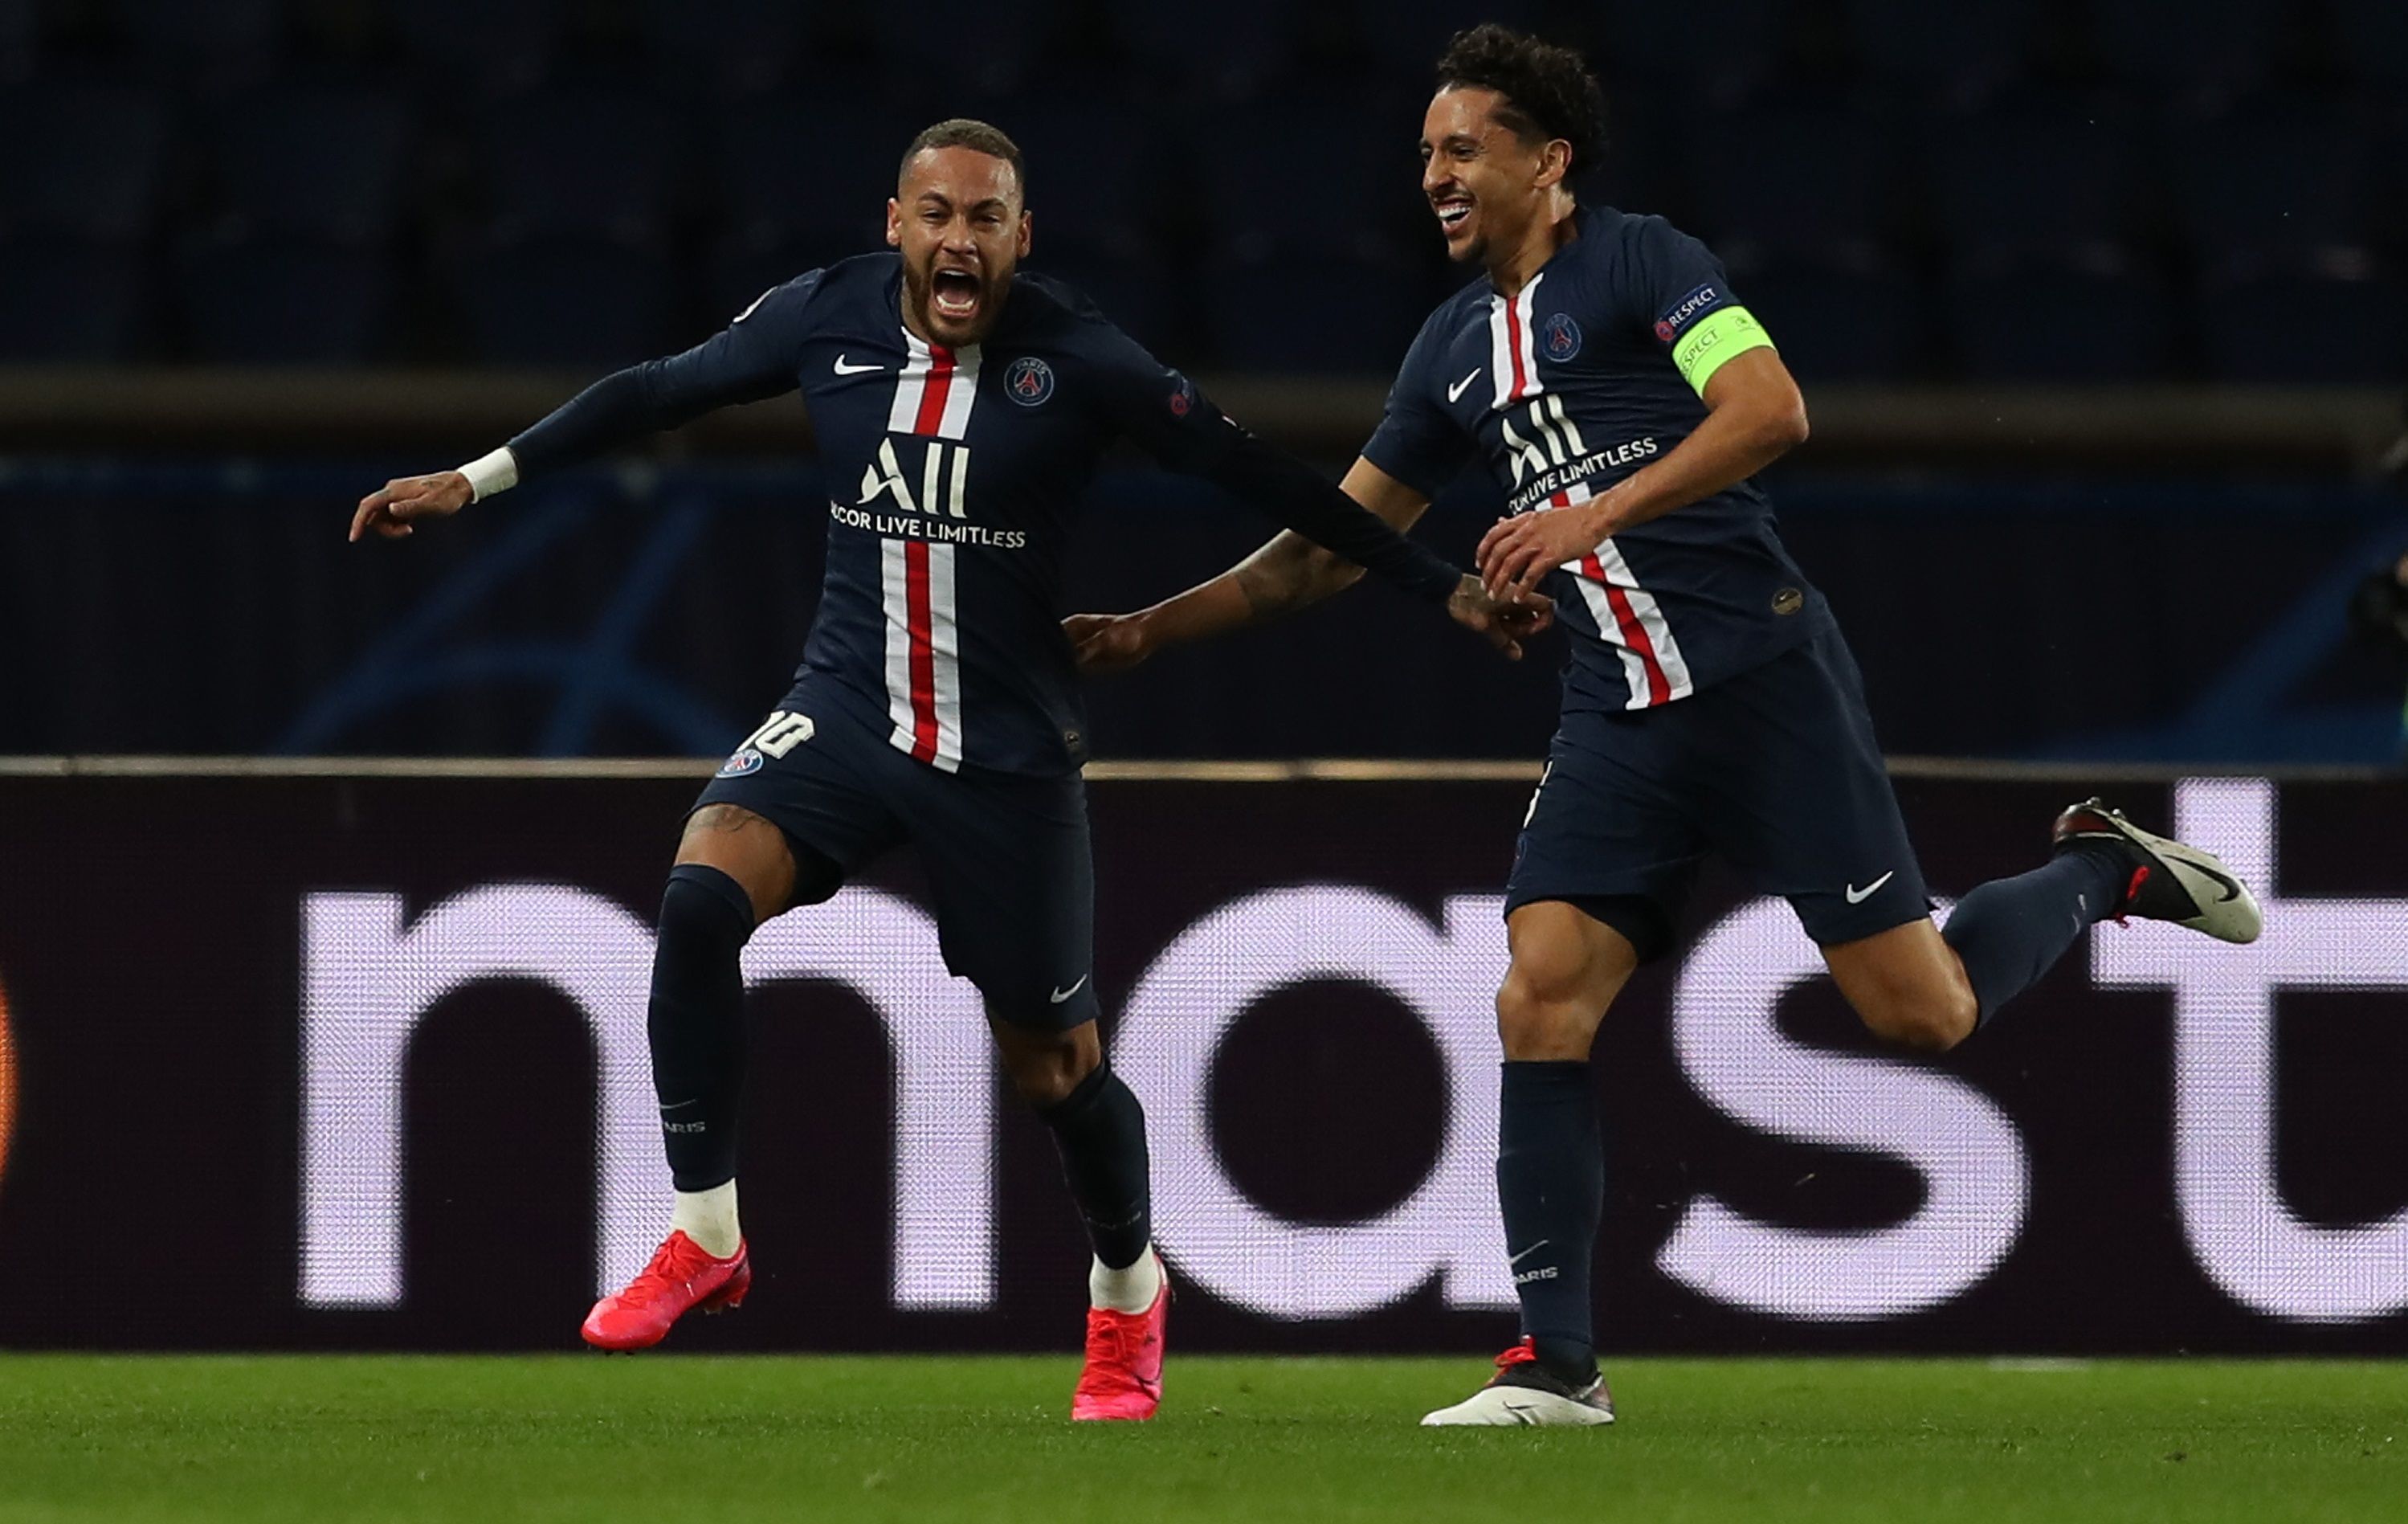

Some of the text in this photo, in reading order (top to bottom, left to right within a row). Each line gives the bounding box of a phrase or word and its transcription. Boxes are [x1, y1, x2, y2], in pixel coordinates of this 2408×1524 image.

[1668, 288, 1716, 327] RESPECT
[1528, 472, 1558, 501] LIVE
[1560, 437, 1658, 484] LIMITLESS
[876, 515, 920, 537] LIVE
[926, 521, 1026, 549] LIMITLESS
[737, 710, 814, 759] 10
[298, 777, 2408, 1322] mast
